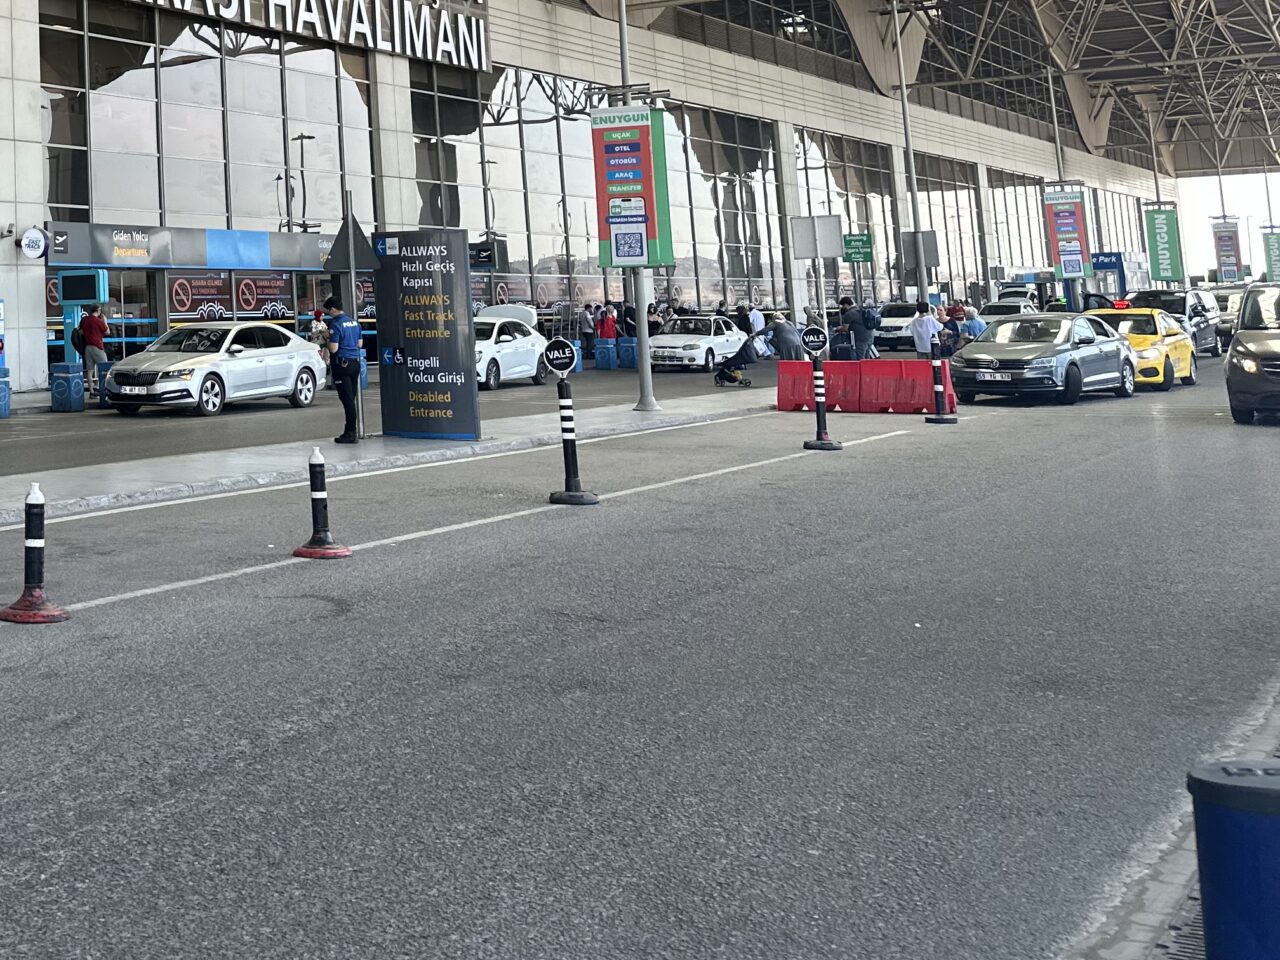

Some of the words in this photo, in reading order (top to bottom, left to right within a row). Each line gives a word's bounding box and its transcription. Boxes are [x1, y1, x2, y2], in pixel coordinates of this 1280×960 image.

[592, 112, 650, 125] ENUYGUN
[612, 132, 631, 140] UÇAK
[610, 157, 637, 165] OTOBÜS
[615, 171, 633, 179] ARAÇ
[608, 184, 642, 192] TRANSFER
[113, 230, 132, 242] Giden
[132, 231, 149, 242] Yolcu
[401, 245, 448, 257] ALLWAYS
[1154, 214, 1169, 277] ENUYGUN
[113, 246, 148, 258] Departures
[1099, 255, 1117, 263] Park
[401, 261, 423, 272] Hızlı
[425, 261, 456, 274] Geçiş
[402, 276, 433, 290] Kapısı
[404, 294, 450, 305] ALLWAYS
[404, 310, 424, 321] Fast
[426, 310, 455, 321] Track
[405, 327, 451, 338] Entrance
[803, 334, 825, 342] VALE
[547, 348, 572, 359] VALE
[407, 356, 440, 370] Engelli
[408, 372, 435, 384] Yolcu
[437, 371, 465, 386] Girişi
[409, 391, 451, 403] Disabled
[410, 406, 453, 418] Entrance
